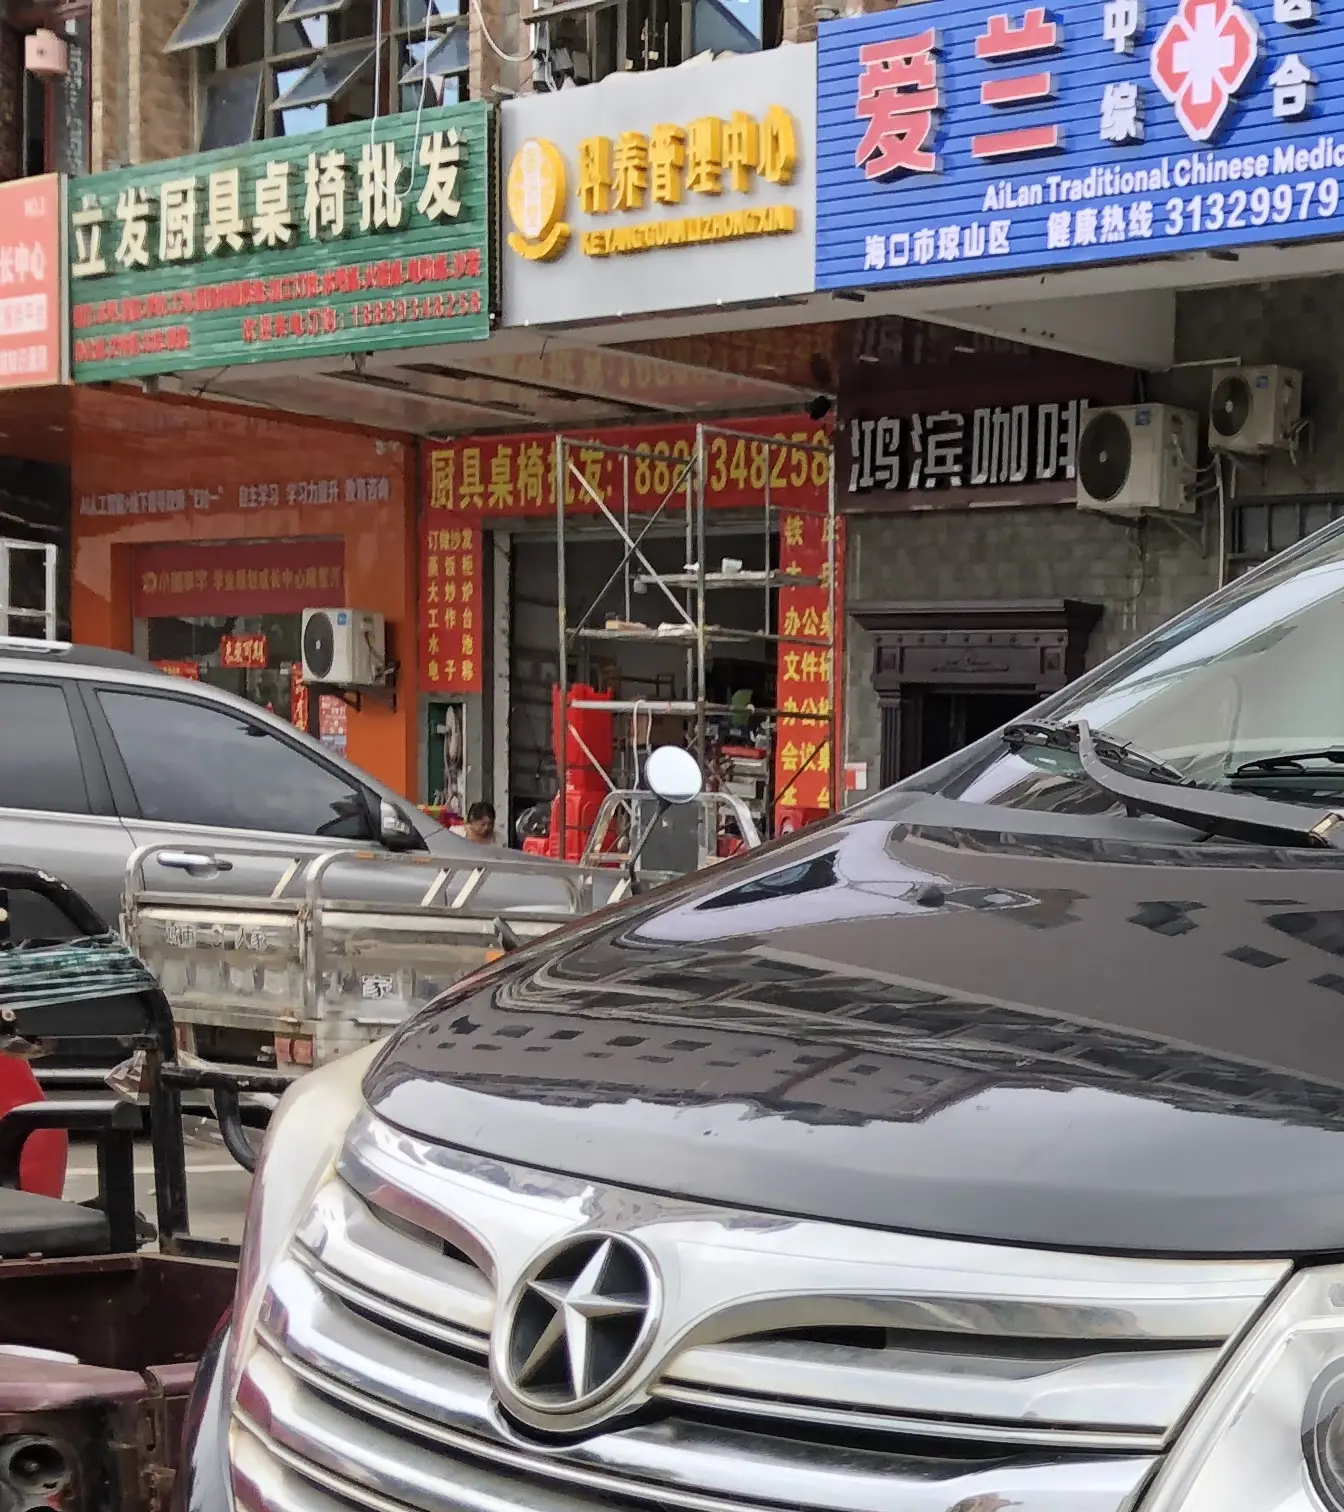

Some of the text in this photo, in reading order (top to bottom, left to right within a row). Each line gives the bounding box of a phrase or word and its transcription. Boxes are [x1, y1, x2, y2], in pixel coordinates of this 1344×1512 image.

[855, 7, 1062, 181] 爱兰
[72, 128, 468, 278] 立发厨具桌椅批发
[577, 104, 797, 215] 科养管理中心
[982, 181, 1042, 213] AiLan
[1046, 157, 1170, 201] Traditional
[1174, 148, 1268, 187] Chinese
[863, 219, 1012, 271] 海口市琼山区
[1047, 201, 1153, 250] 健康热线
[1165, 177, 1340, 236] 31329979
[427, 606, 473, 630] 工作台
